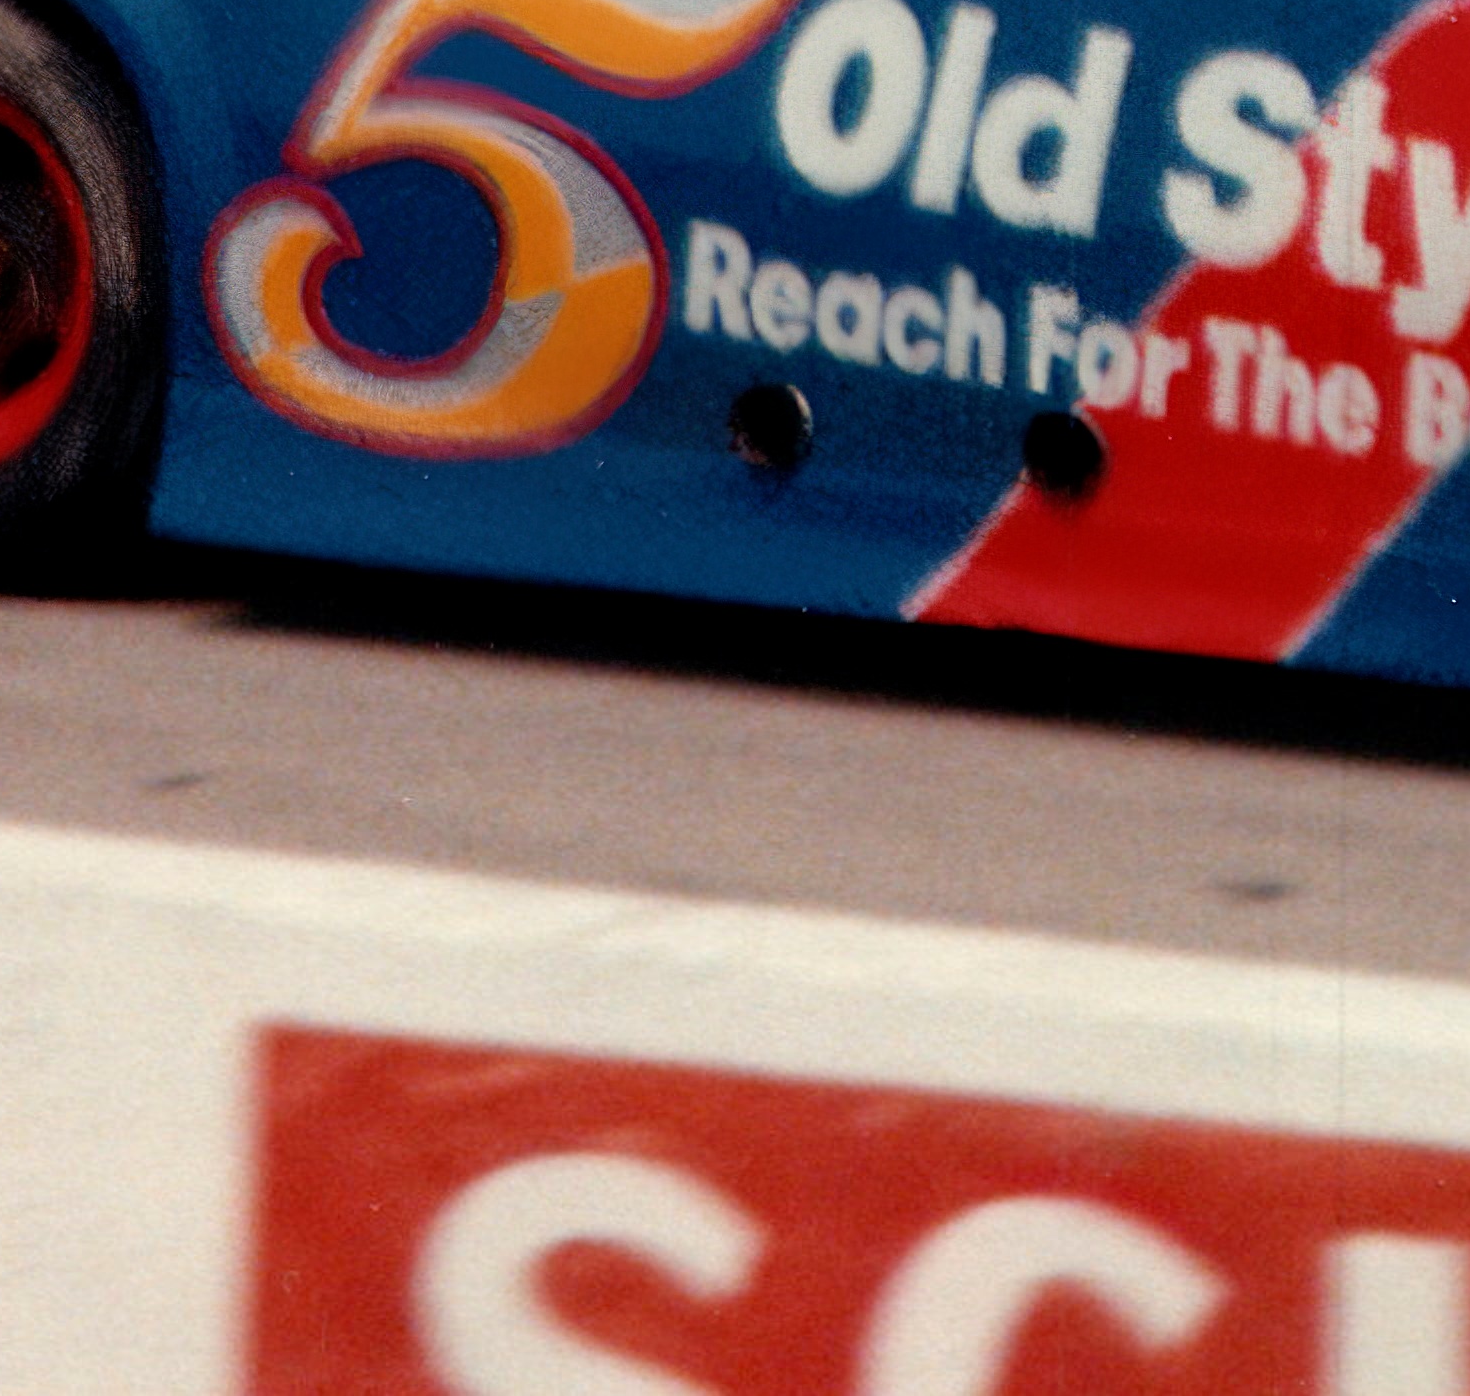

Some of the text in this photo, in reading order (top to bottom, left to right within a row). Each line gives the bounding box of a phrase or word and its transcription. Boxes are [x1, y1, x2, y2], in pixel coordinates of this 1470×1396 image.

[683, 217, 1008, 390] Reach
[1029, 282, 1191, 420] For
[1204, 315, 1381, 456] The
